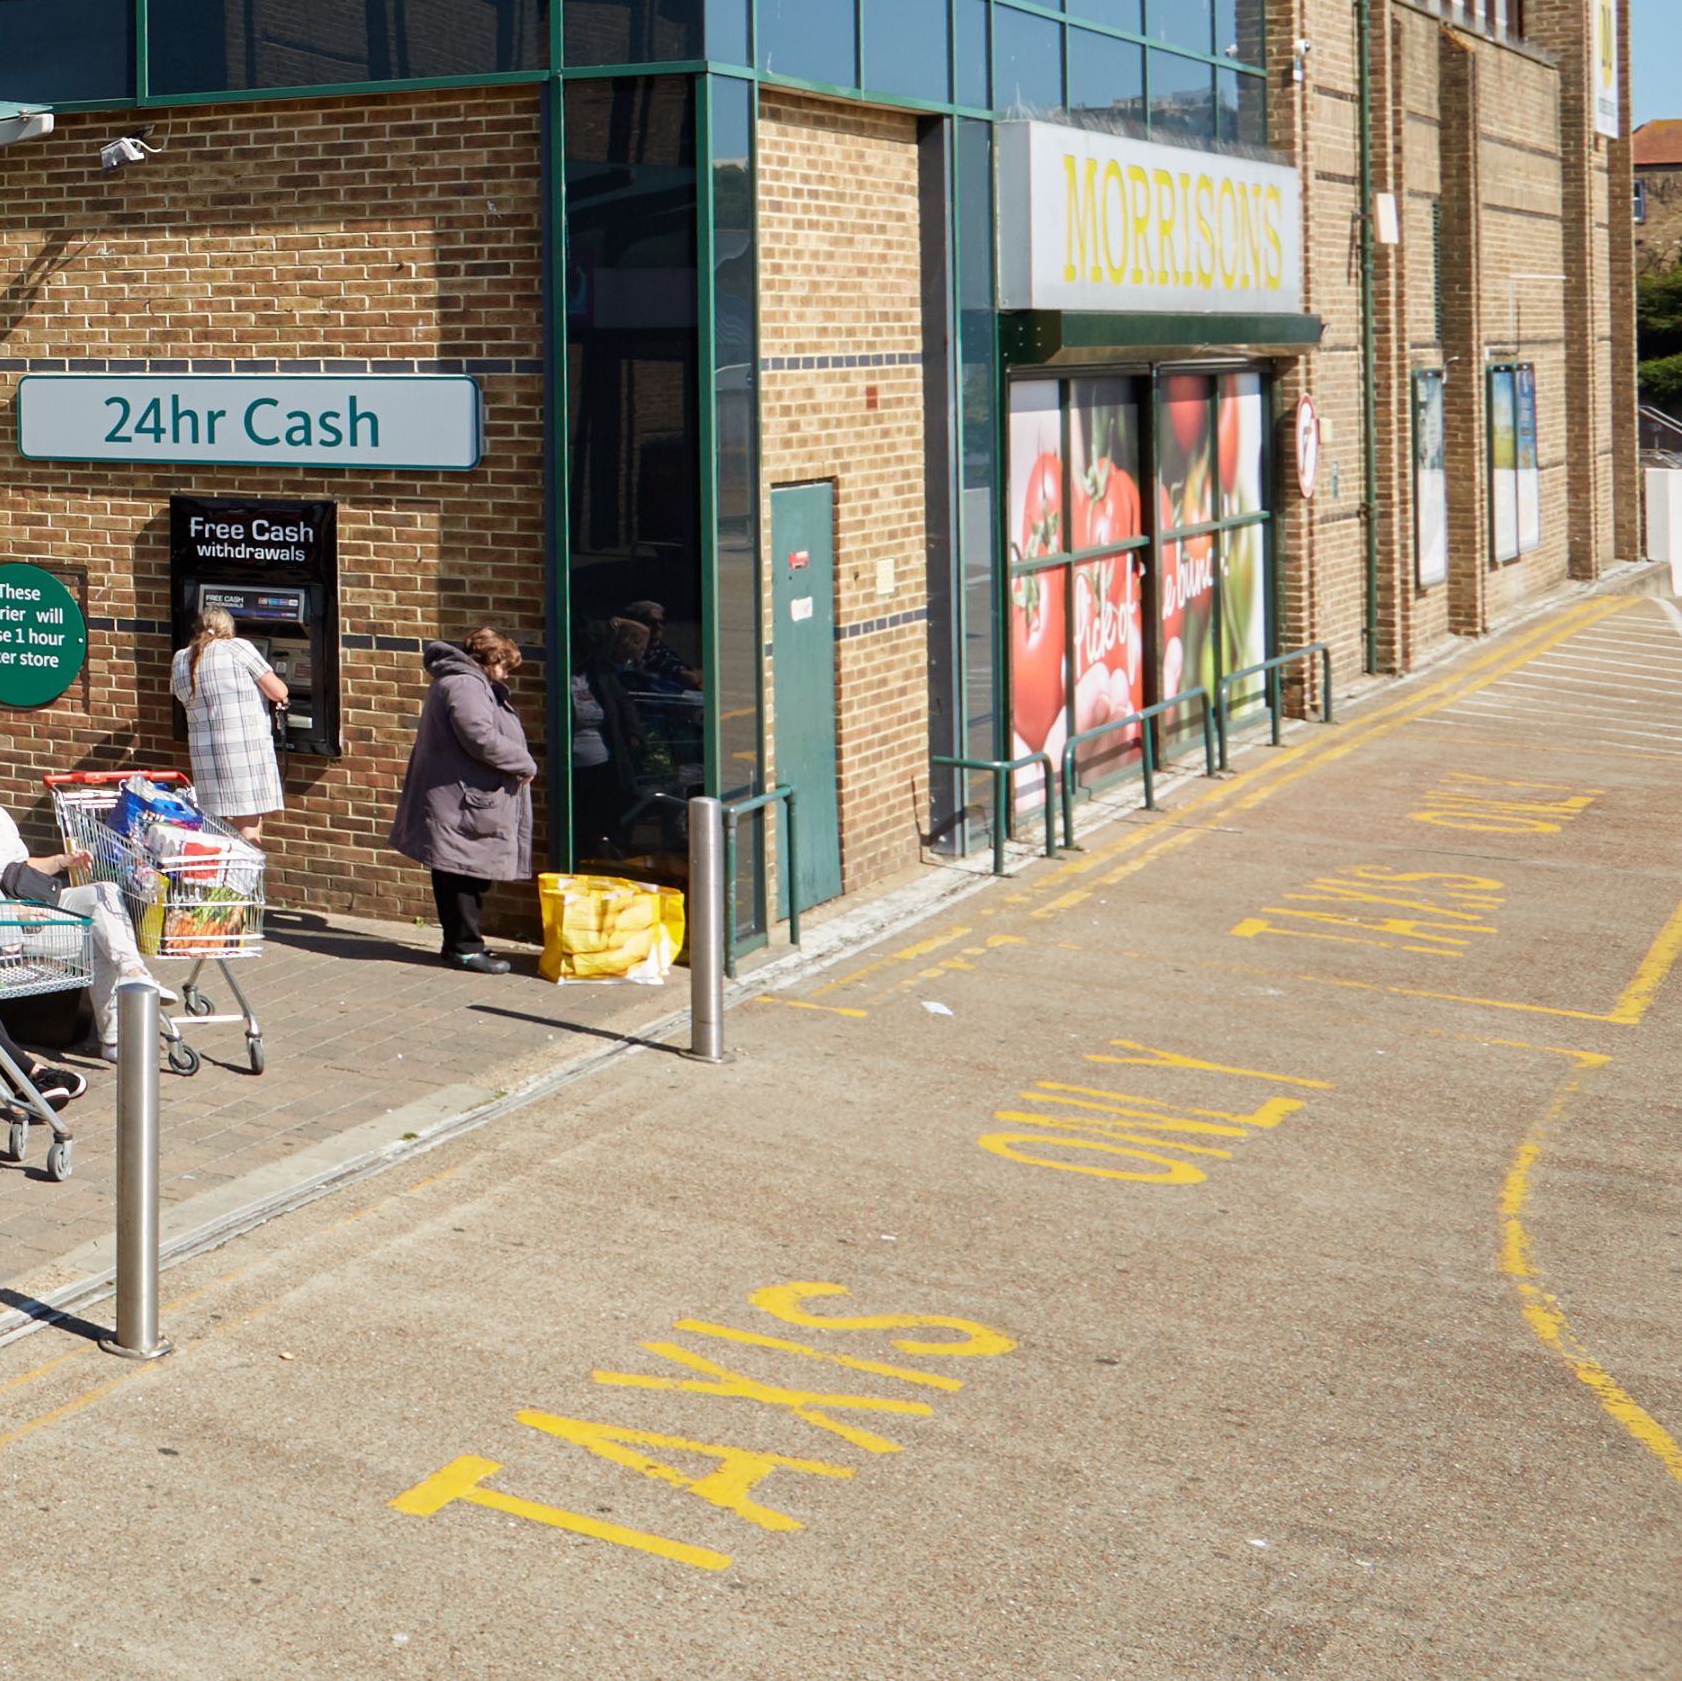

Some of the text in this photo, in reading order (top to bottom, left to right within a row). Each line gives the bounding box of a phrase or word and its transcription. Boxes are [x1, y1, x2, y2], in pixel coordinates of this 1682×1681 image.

[1062, 153, 1283, 292] MORRISONS
[103, 393, 380, 448] 24hr Cash
[189, 517, 315, 544] Free Cash
[196, 542, 306, 562] withdrawals
[36, 608, 64, 624] will
[15, 628, 25, 644] 1
[28, 628, 66, 646] hour
[19, 650, 59, 668] store
[1230, 863, 1507, 958] TAXIS
[978, 1039, 1339, 1187] ONLY
[387, 1280, 1019, 1572] TAXIS
